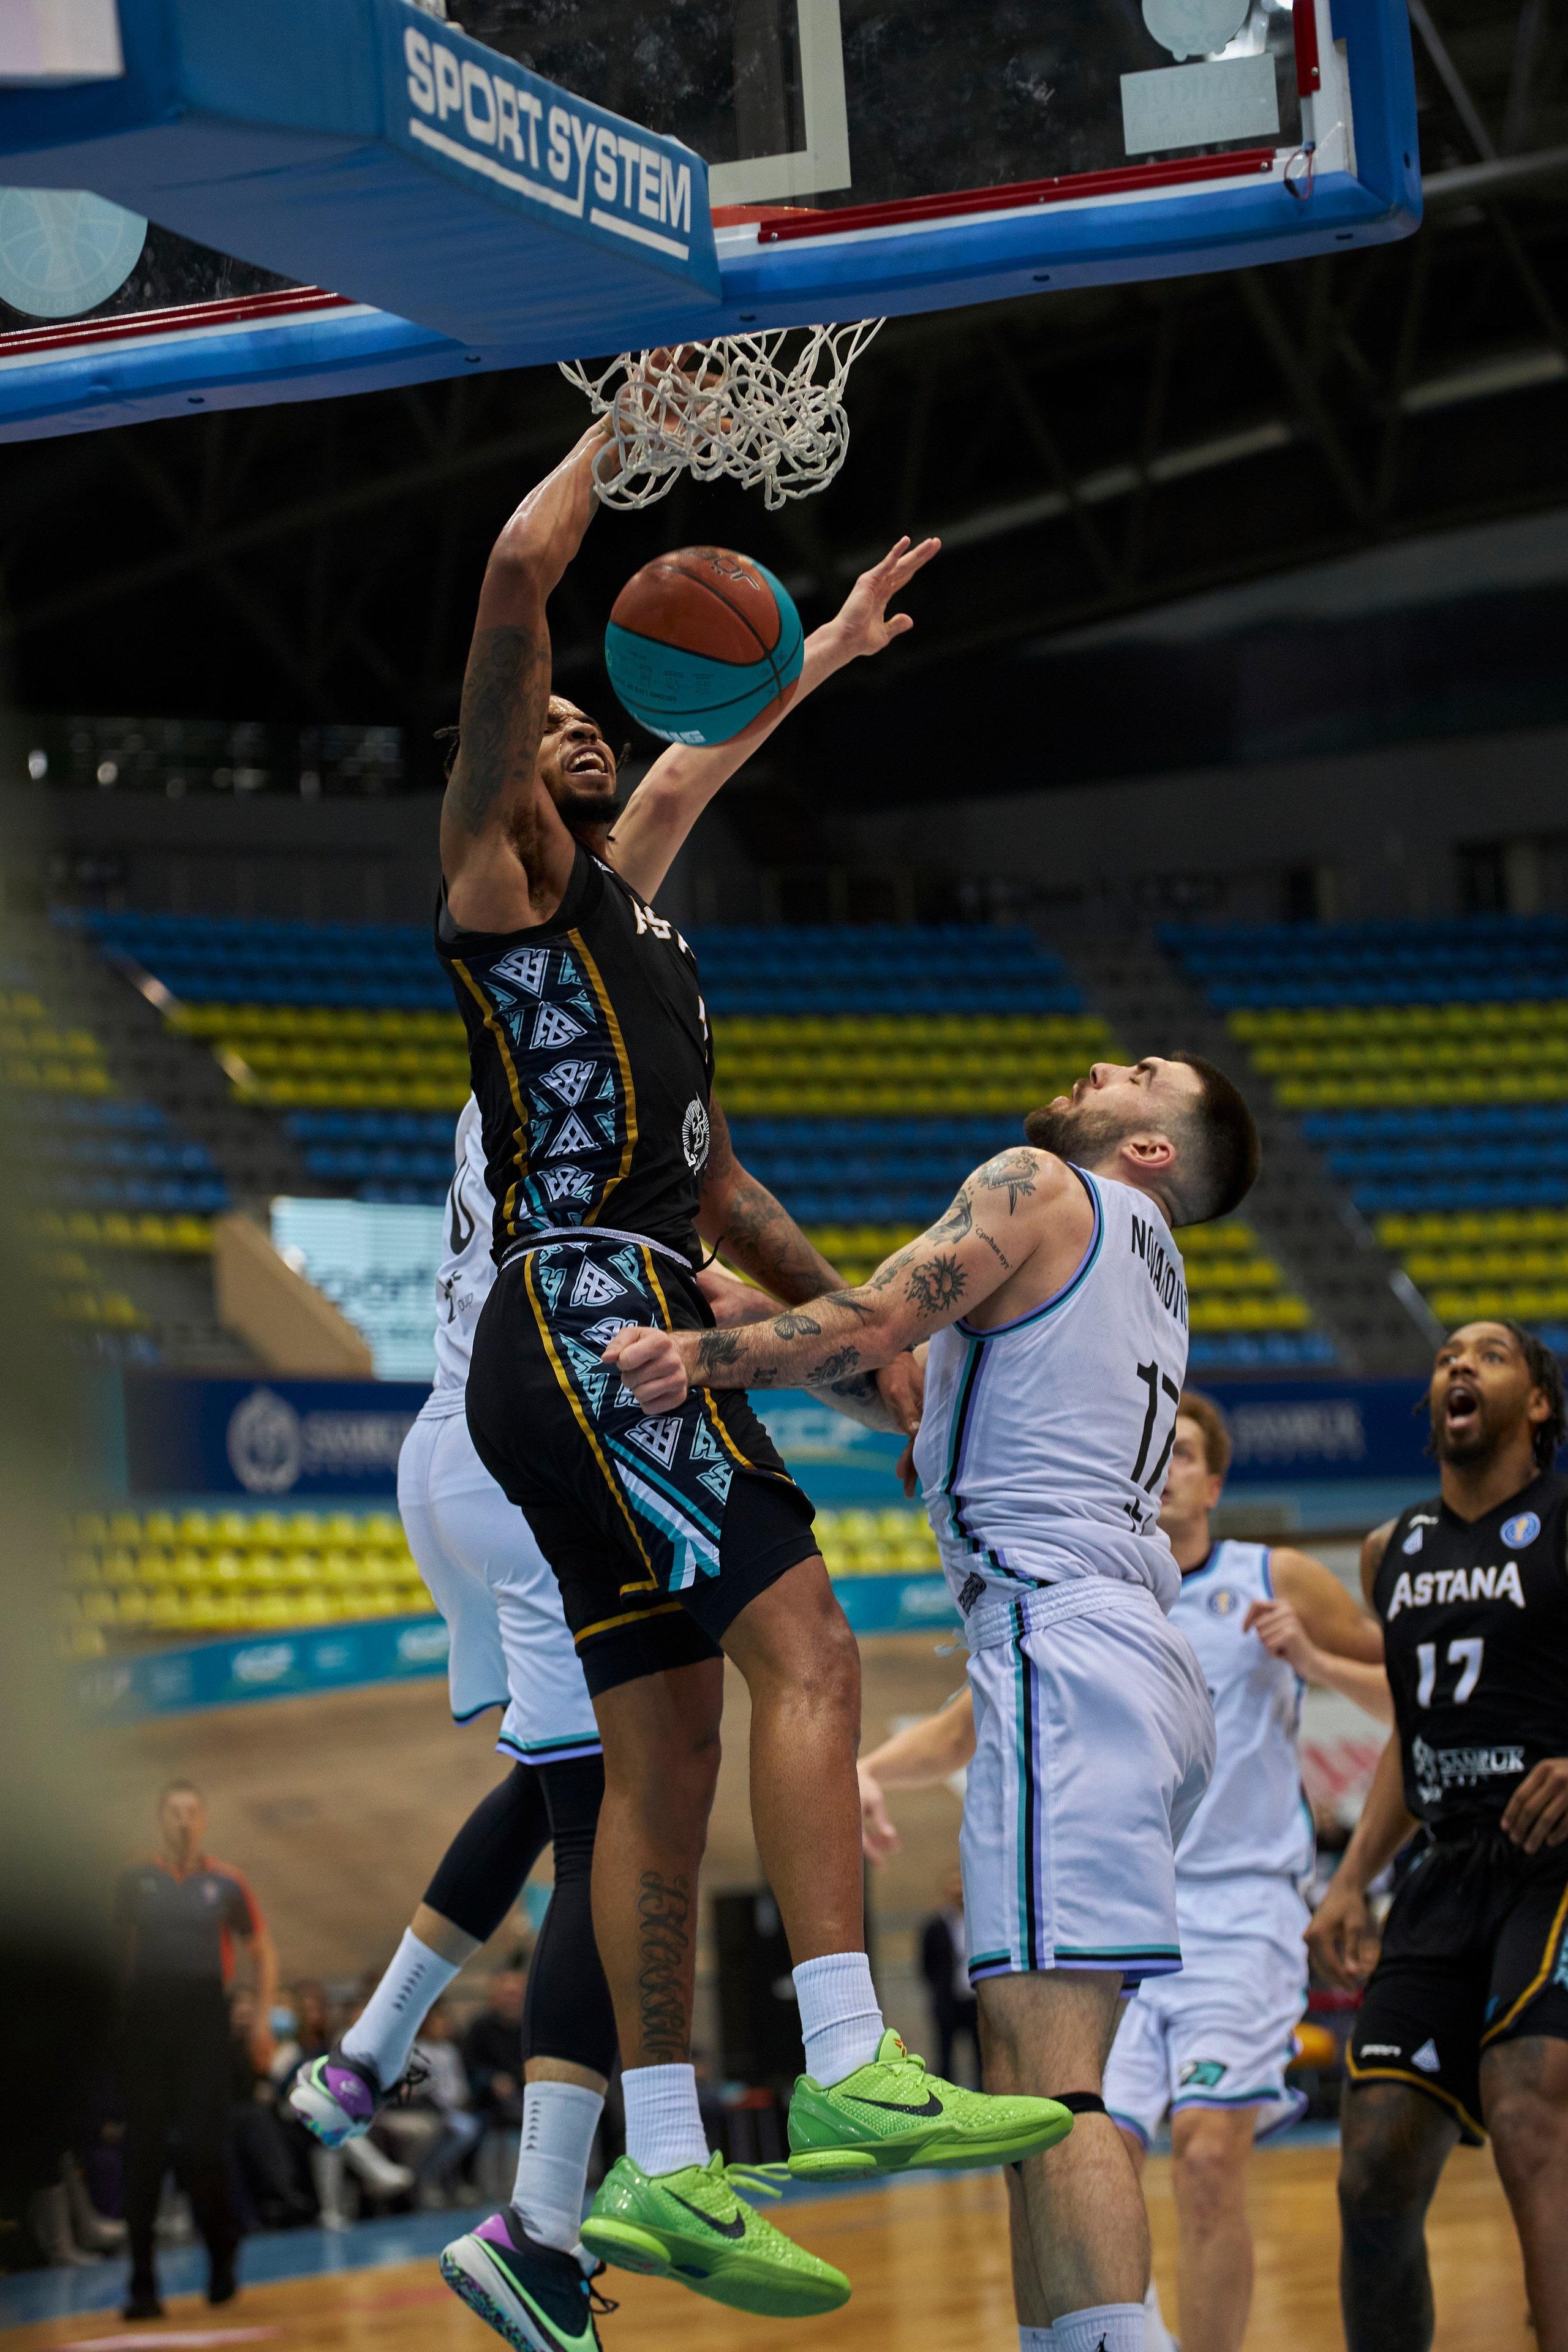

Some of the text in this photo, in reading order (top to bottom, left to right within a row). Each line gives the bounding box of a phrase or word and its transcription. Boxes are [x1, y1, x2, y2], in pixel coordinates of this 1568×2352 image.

[404, 26, 691, 233] SPORT SYSTEM
[1131, 1360, 1180, 1494] 17
[1387, 1561, 1526, 1621] ASTANA
[1416, 1637, 1485, 1709] 17
